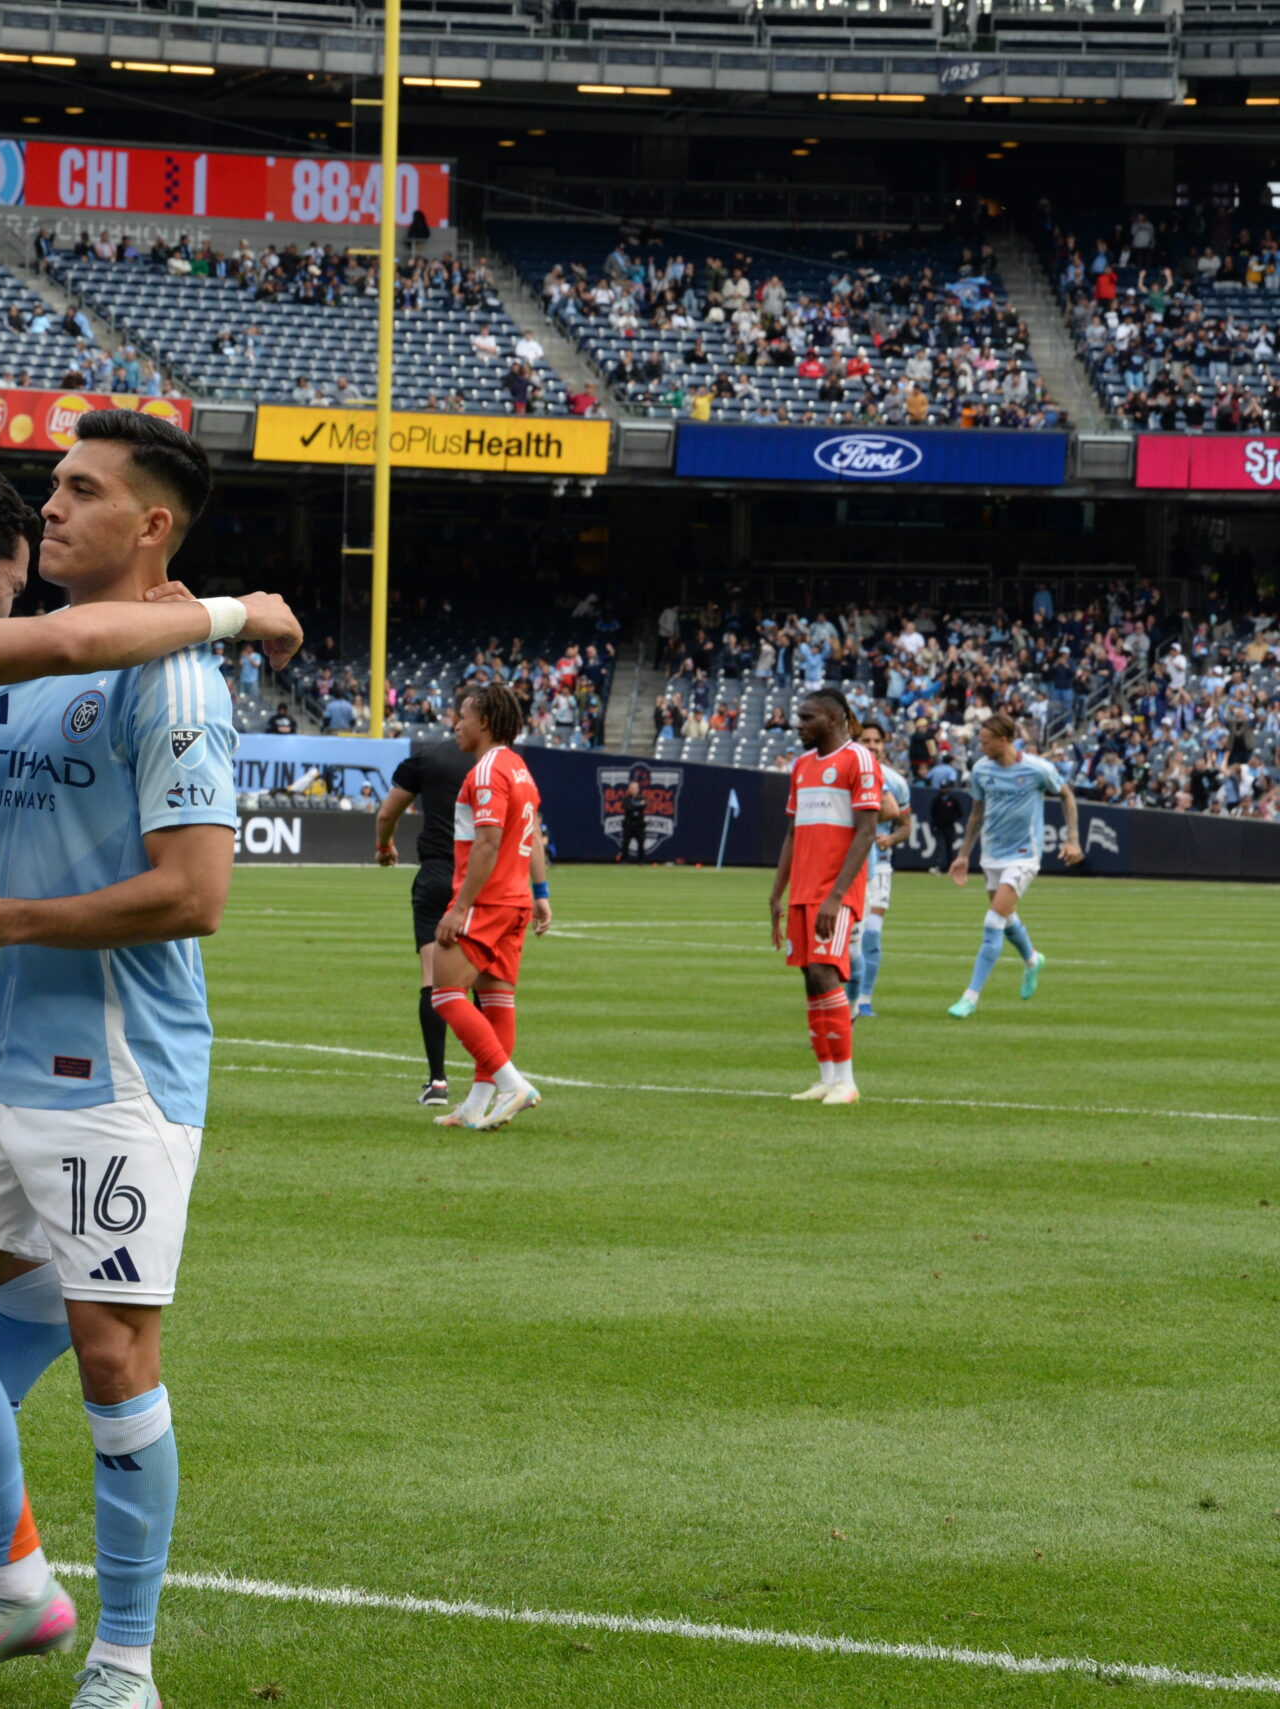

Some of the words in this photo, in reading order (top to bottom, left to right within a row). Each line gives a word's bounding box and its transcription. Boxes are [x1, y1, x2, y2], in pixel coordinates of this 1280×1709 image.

[59, 148, 128, 209] CHI
[194, 154, 207, 215] 1
[292, 160, 420, 224] 88:40
[328, 423, 563, 459] MetoPlusHealth
[831, 440, 904, 470] Ford
[172, 732, 194, 742] MLS
[62, 1155, 147, 1236] 16
